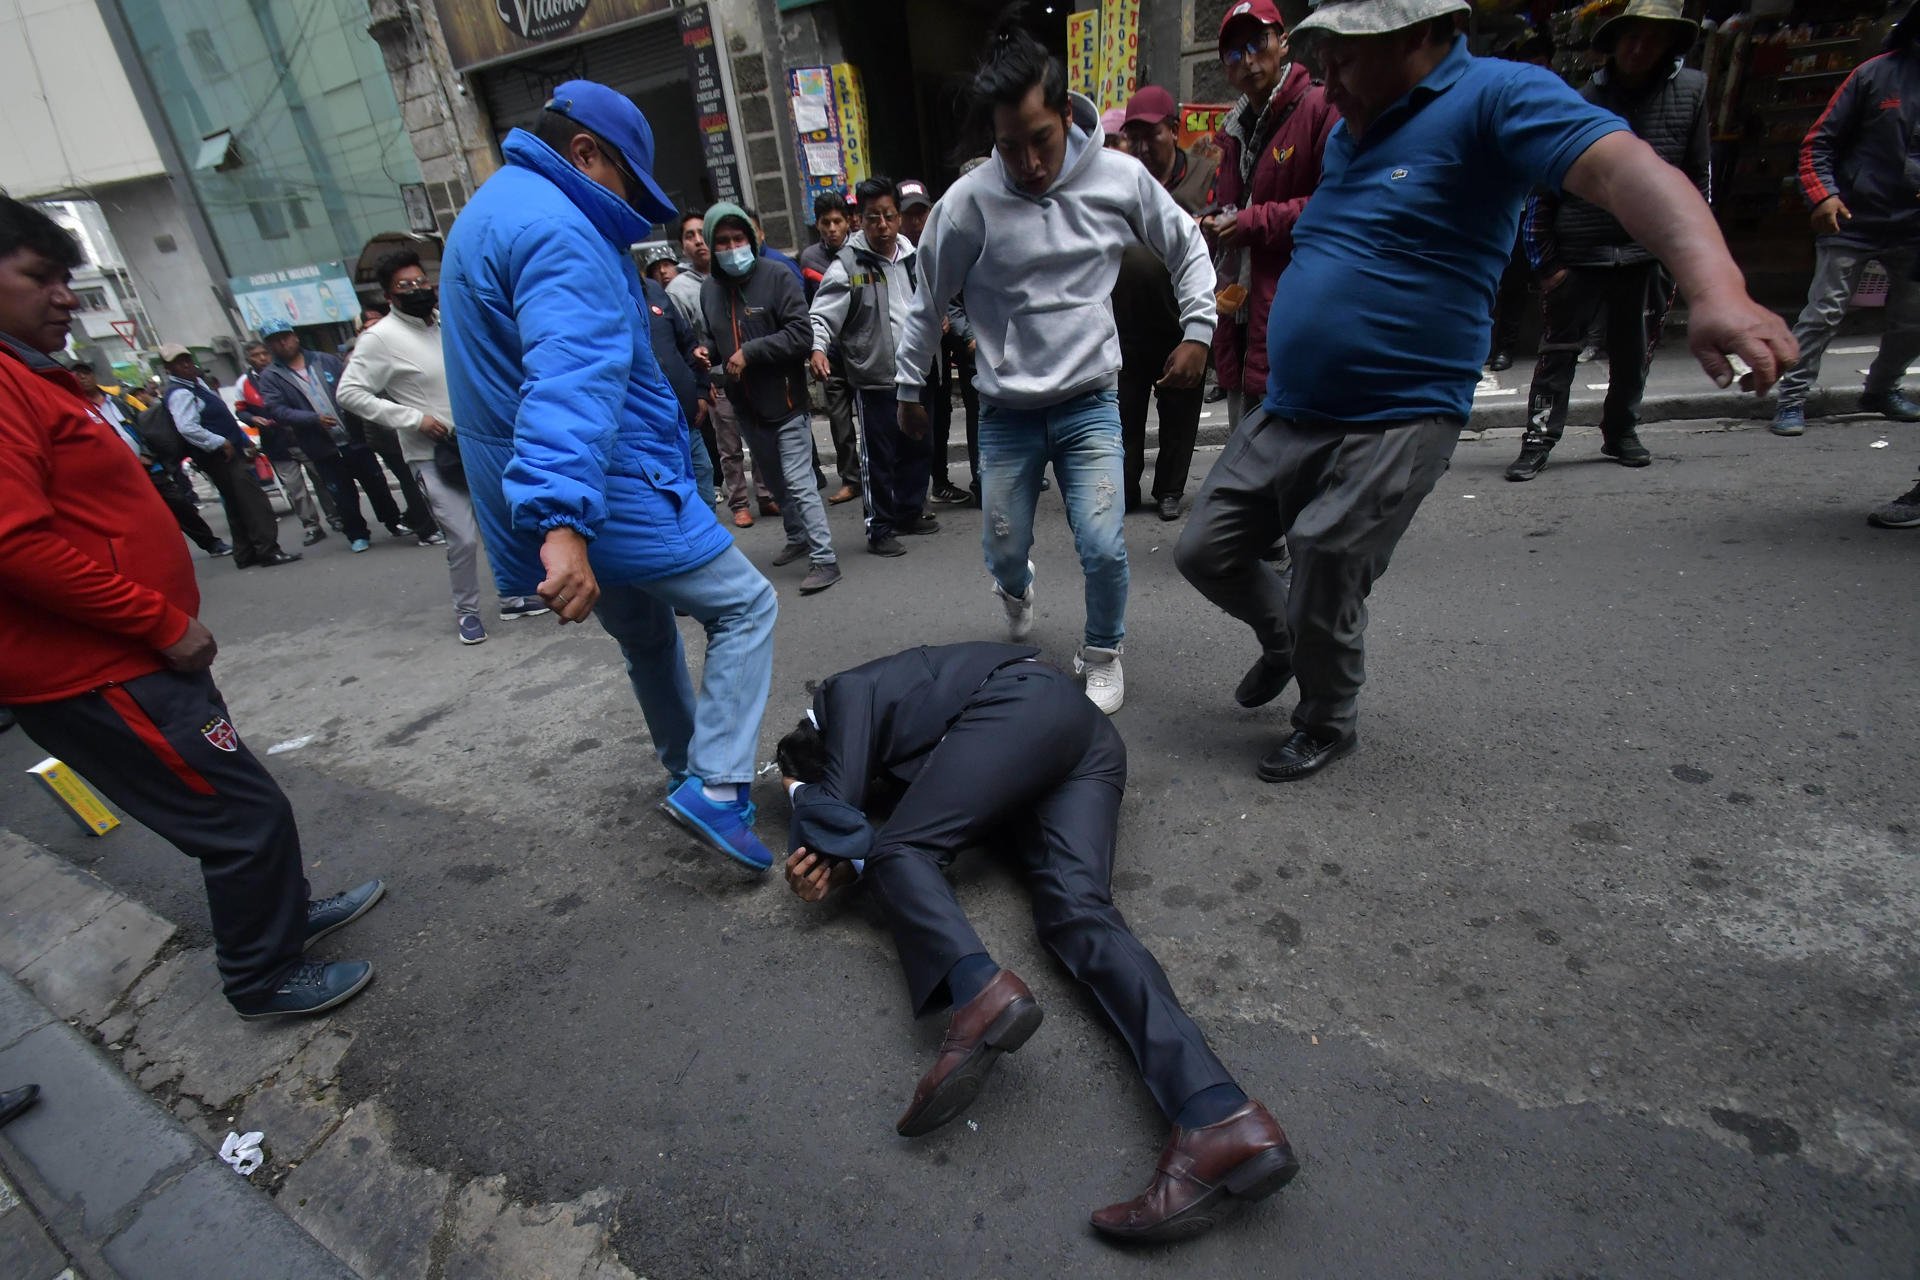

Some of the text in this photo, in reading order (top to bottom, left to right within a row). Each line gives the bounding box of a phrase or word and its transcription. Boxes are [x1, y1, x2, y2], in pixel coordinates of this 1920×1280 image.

[838, 75, 859, 165] SELLOS
[1186, 111, 1210, 133] SE
[715, 166, 730, 177] POLLO
